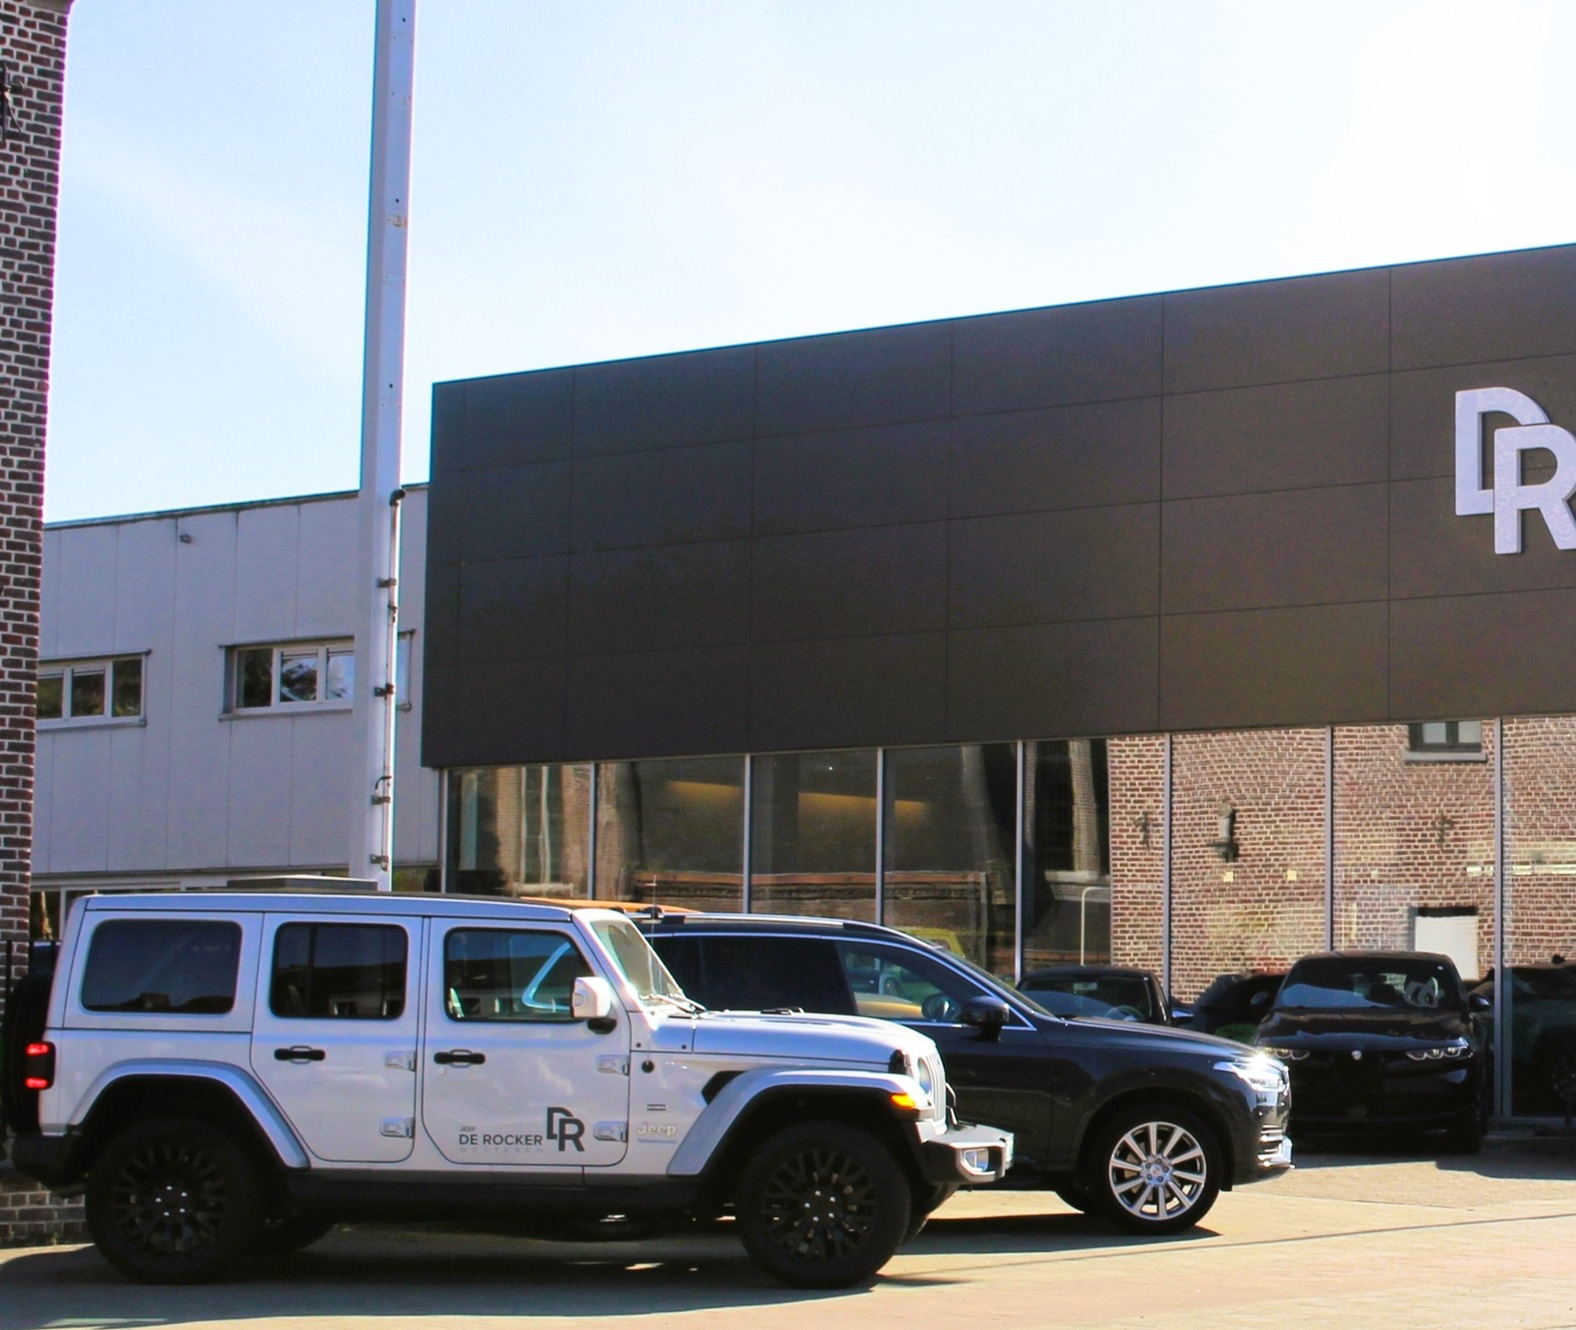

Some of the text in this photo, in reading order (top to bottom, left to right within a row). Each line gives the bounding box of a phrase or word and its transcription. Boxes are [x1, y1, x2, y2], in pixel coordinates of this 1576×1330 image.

[546, 1106, 585, 1152] DR
[636, 1121, 677, 1137] Jeep
[459, 1134, 543, 1146] DE ROCKER
